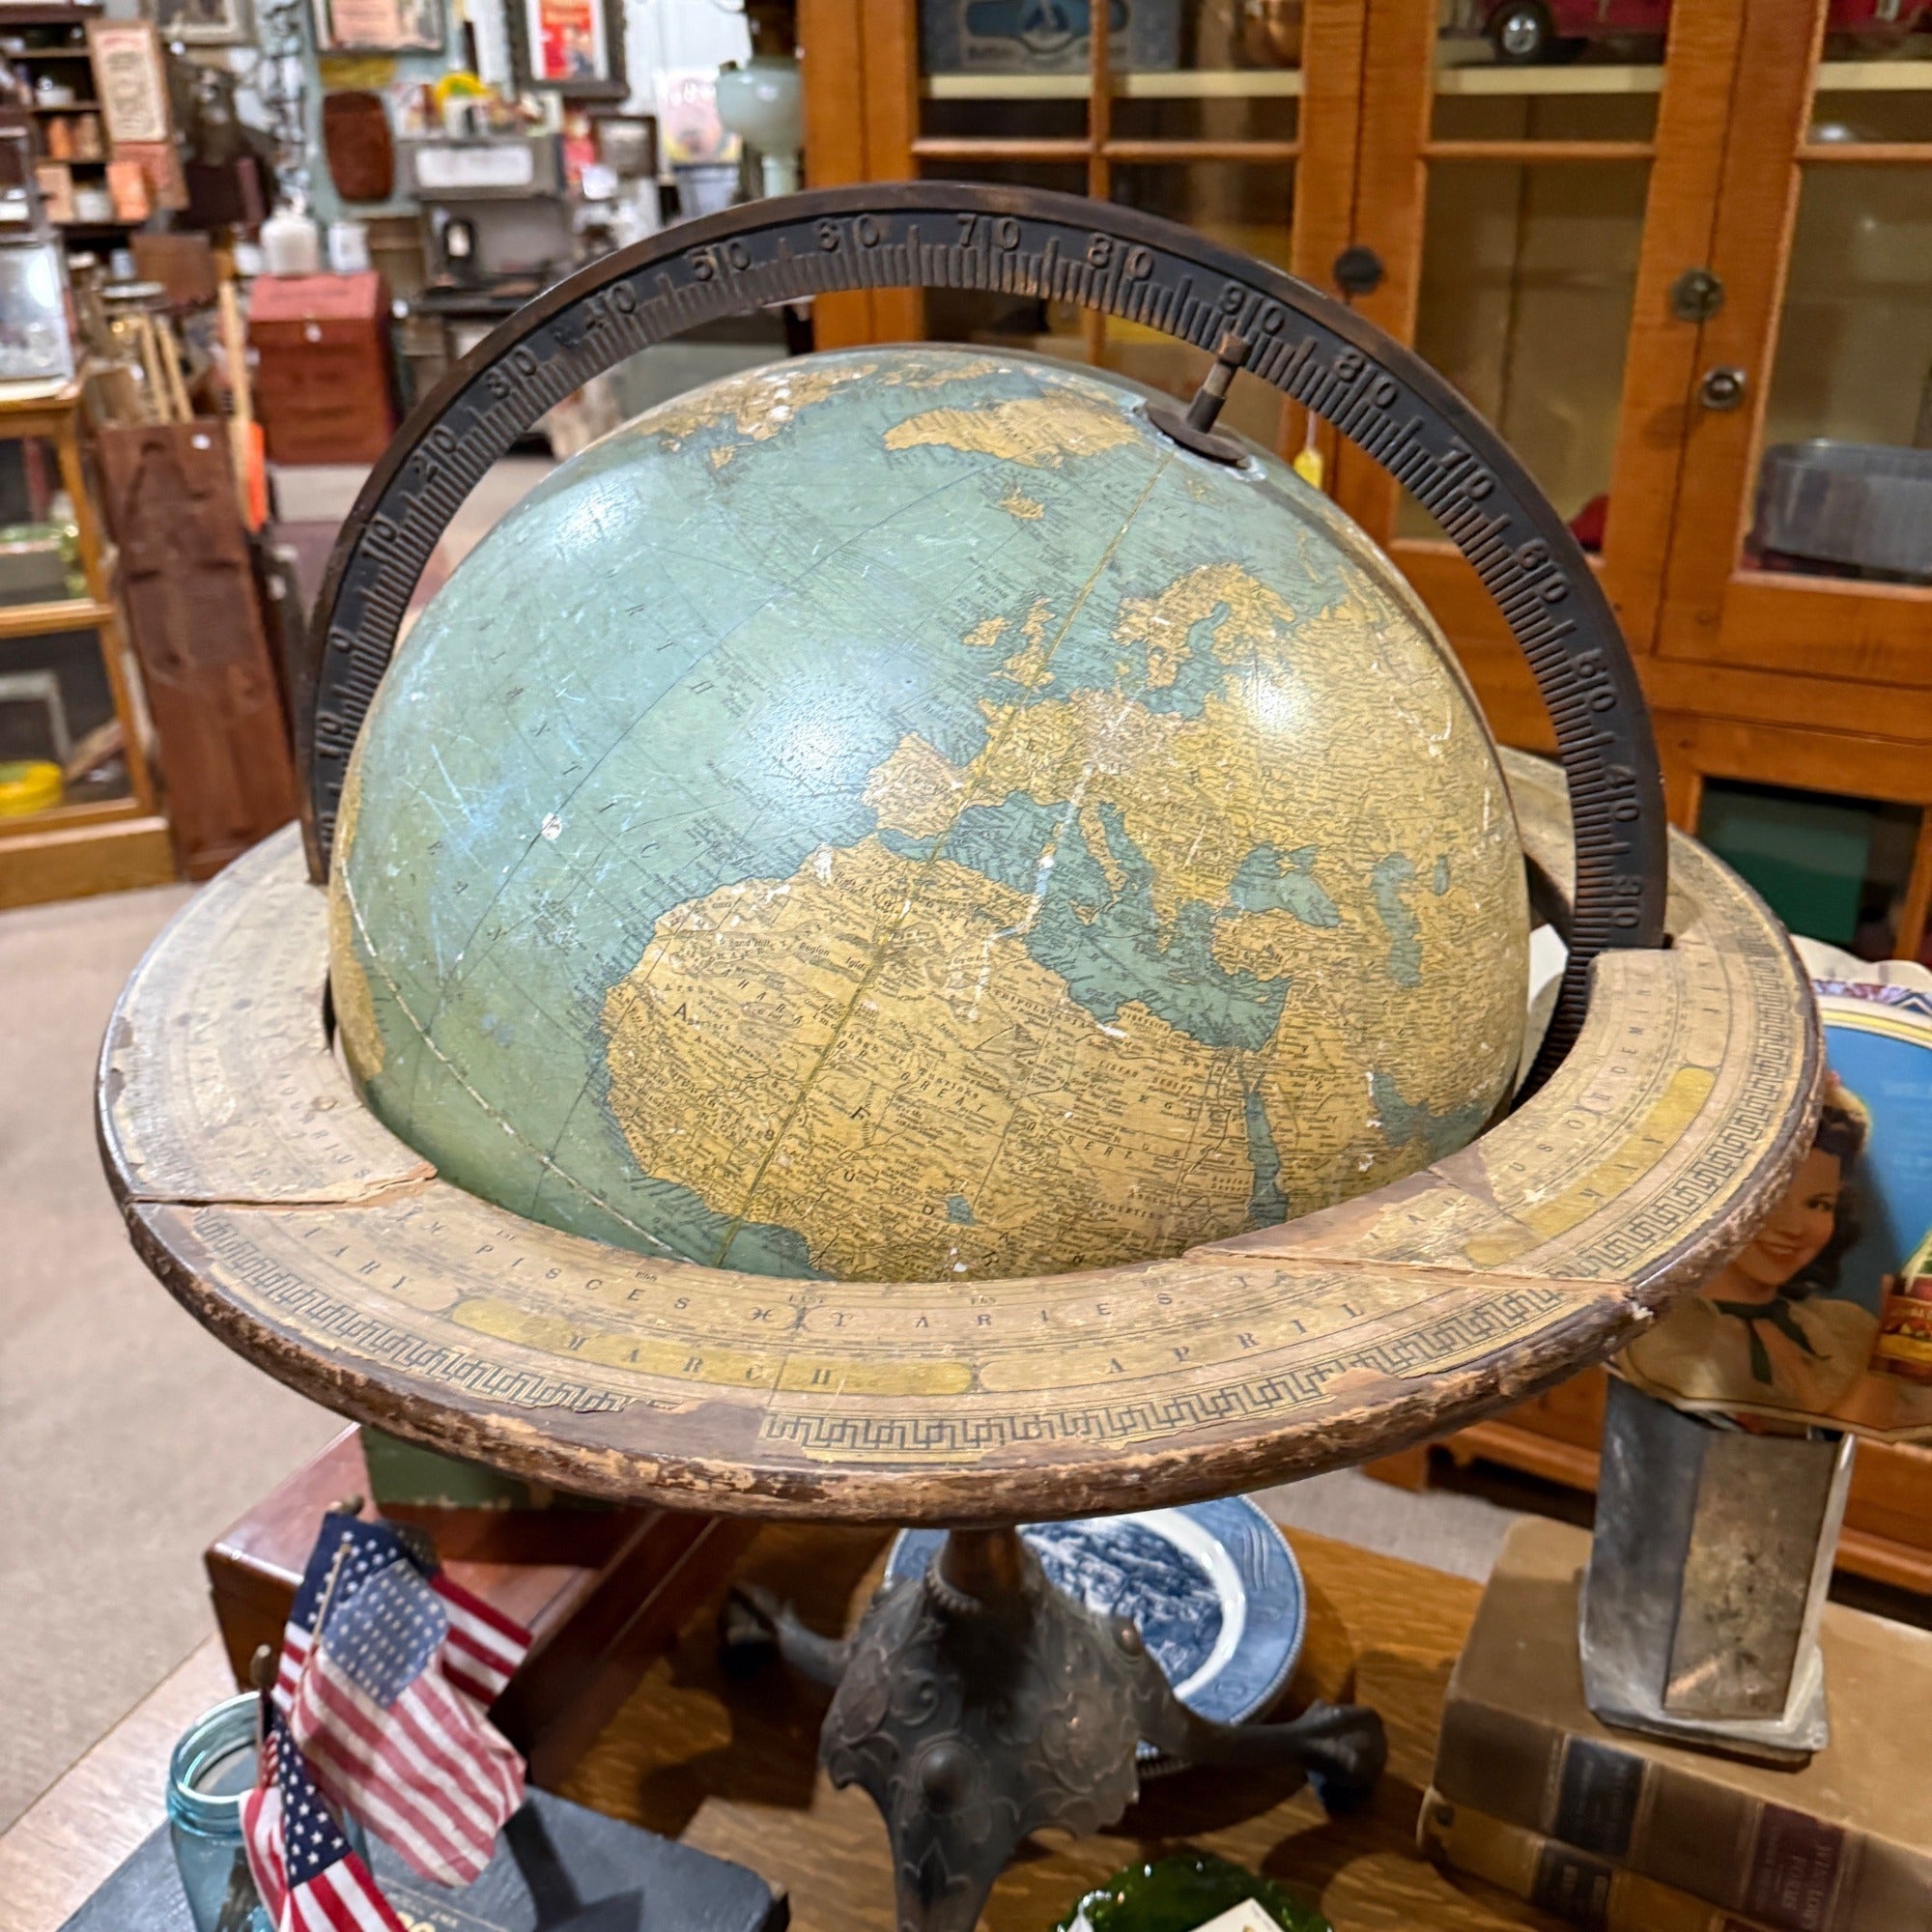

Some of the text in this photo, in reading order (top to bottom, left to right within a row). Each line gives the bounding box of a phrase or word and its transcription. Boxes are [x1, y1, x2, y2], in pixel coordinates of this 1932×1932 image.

[955, 213, 1022, 250] 70
[1086, 233, 1153, 279] 80
[690, 242, 752, 282] 50
[1218, 285, 1288, 335] 90
[488, 348, 538, 399] 30
[1335, 352, 1400, 408] 80
[1441, 435, 1495, 503] 70
[364, 516, 399, 560] 10
[1518, 538, 1569, 607] 60
[1612, 874, 1641, 928] 30
[799, 943, 830, 956] Region
[900, 1071, 986, 1112] GREAT
[1582, 1135, 1664, 1200] MAY
[475, 1242, 691, 1310] PISCES
[915, 1293, 1173, 1329] ARIES
[568, 1333, 832, 1385] MARCH
[1106, 1301, 1365, 1375] APRIL
